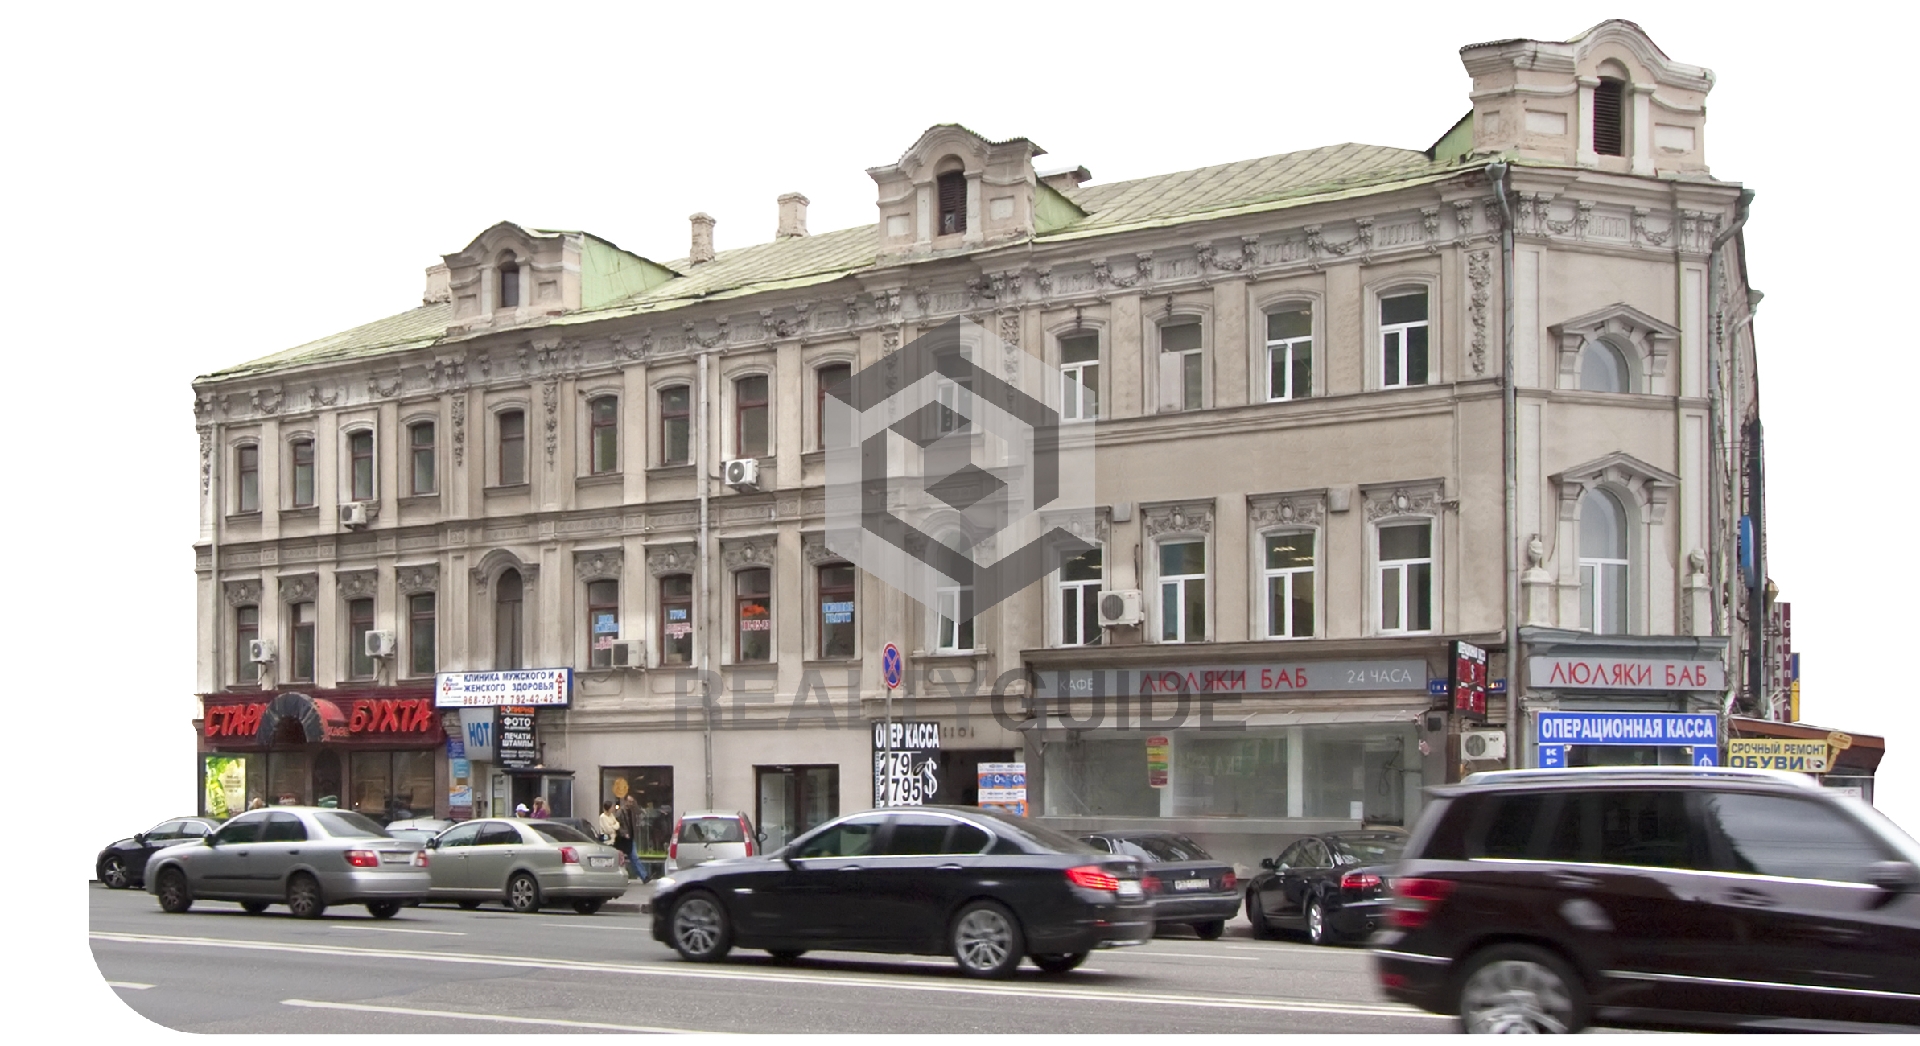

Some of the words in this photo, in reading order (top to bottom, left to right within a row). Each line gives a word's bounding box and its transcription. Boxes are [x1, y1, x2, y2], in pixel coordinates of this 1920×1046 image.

[463, 673, 499, 683] КЛИНИКА
[502, 672, 546, 682] МУЖСКОГО
[548, 671, 555, 680] И
[1059, 678, 1094, 691] КАФЕ
[1140, 670, 1246, 693] ЛЮЛЯКИ
[1261, 668, 1308, 690] БАБ
[1347, 670, 1365, 683] 24
[1370, 668, 1412, 683] ЧАСА
[1550, 661, 1652, 686] ЛЮЛЯКИ
[1665, 664, 1707, 687] БАБ
[463, 683, 505, 693] ЖЕНСКОГО
[512, 682, 555, 693] ЗДОРОВЬЯ
[350, 699, 433, 732] БУХТА
[504, 717, 531, 727] ФОТО
[504, 732, 531, 740] ПЕЧАТИ
[875, 723, 904, 748] ОЕР
[905, 723, 940, 748] КАССА
[1542, 718, 1663, 742] ОПЕРАЦИОННАЯ
[1666, 718, 1714, 739] КАССА
[1731, 741, 1781, 755] СРОЧНЫЙ
[1784, 744, 1826, 756] РЕМОНТ
[1730, 755, 1804, 770] ОБУВИ
